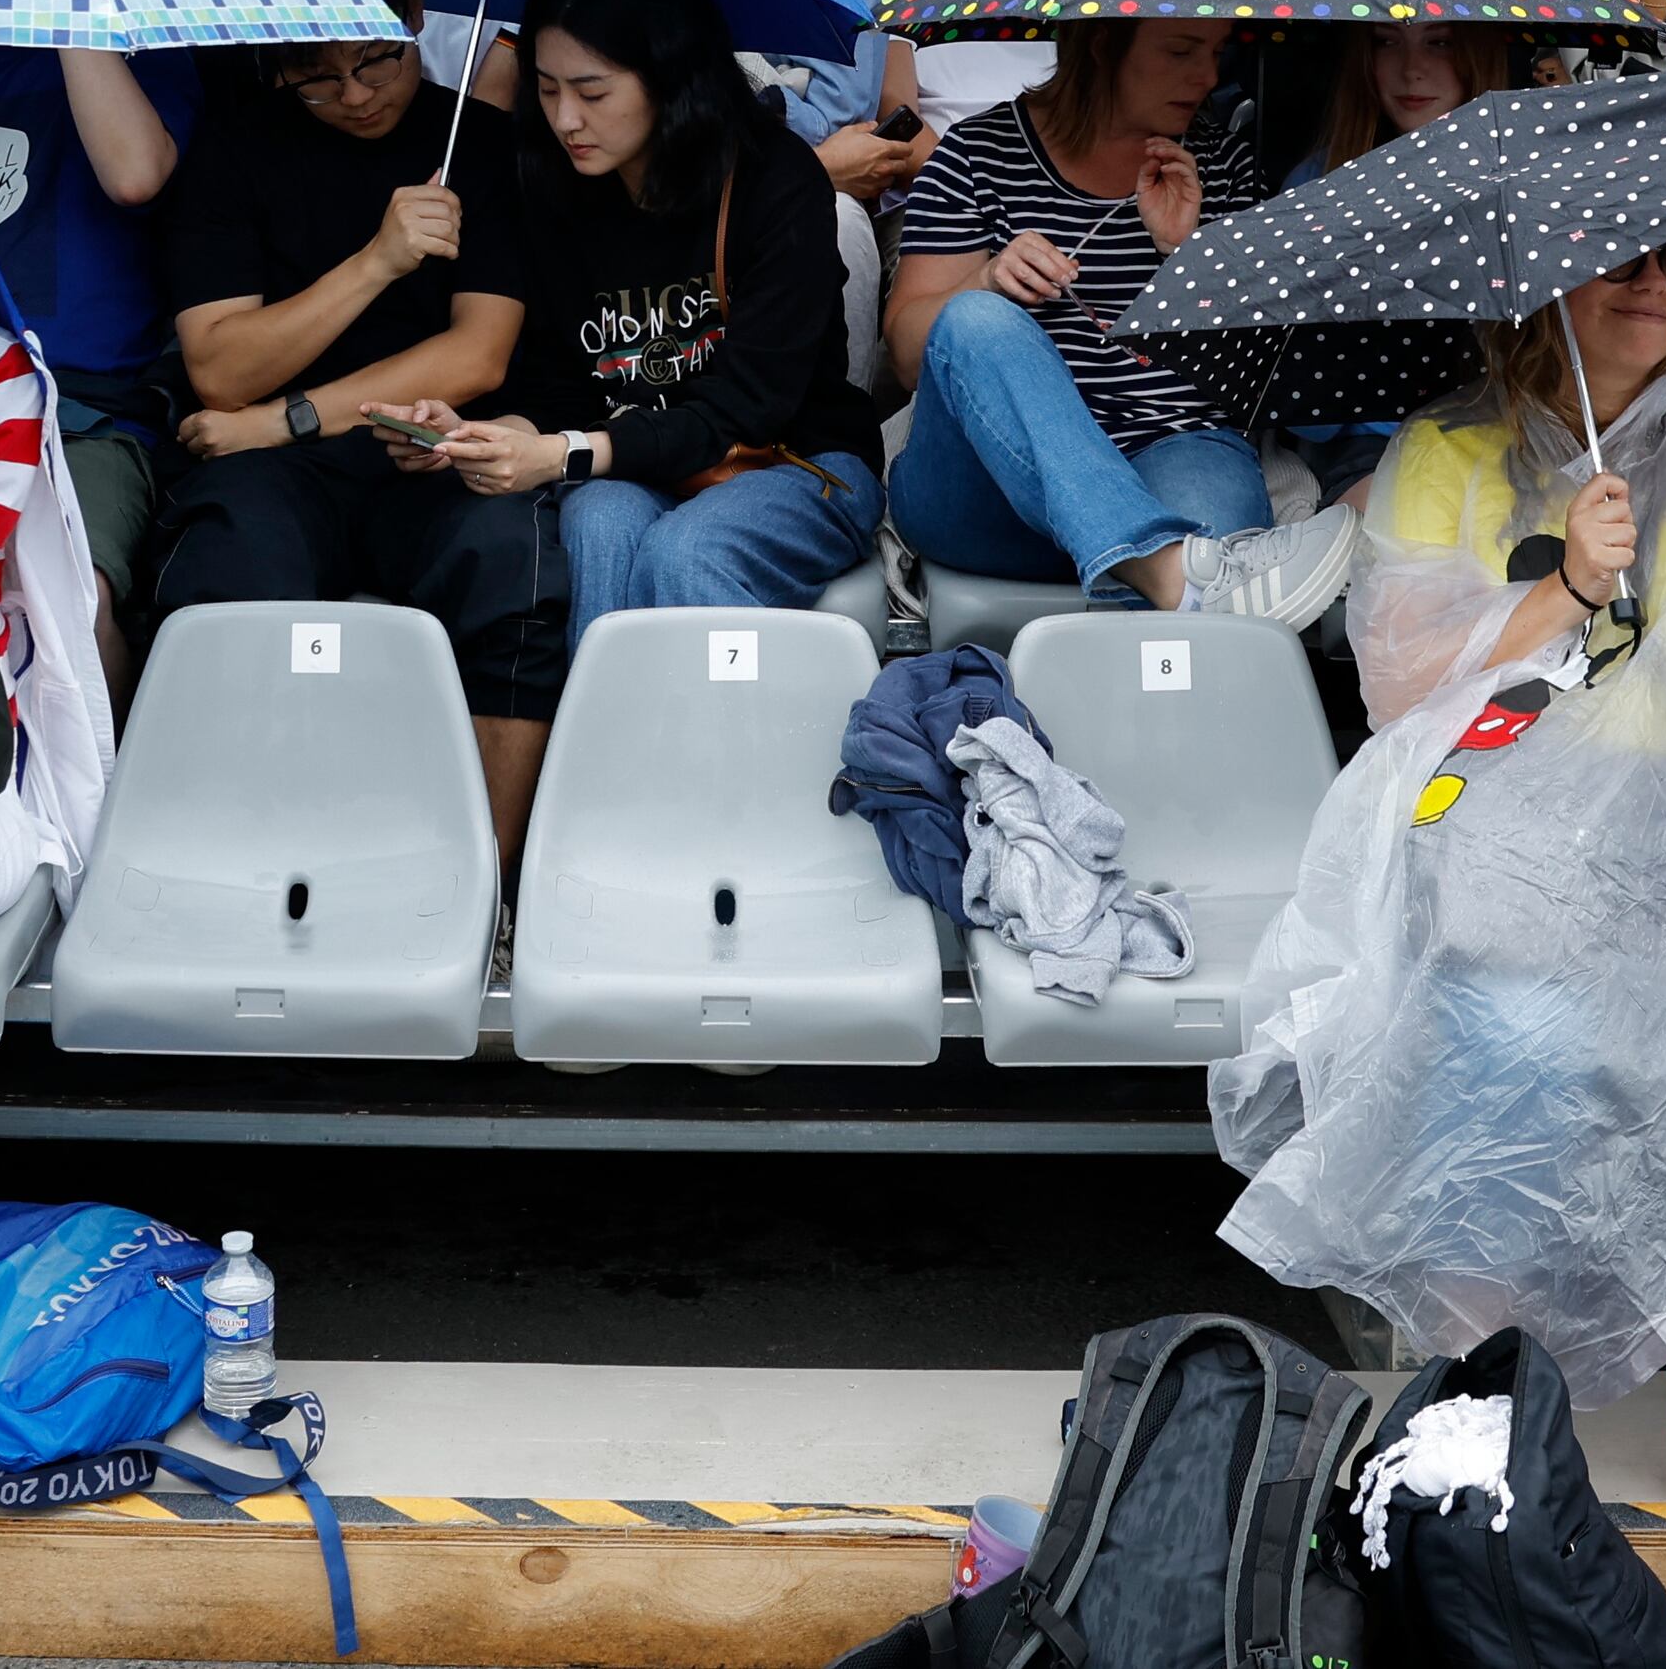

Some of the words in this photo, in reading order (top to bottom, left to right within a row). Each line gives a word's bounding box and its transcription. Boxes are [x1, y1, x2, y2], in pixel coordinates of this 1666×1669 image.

[310, 639, 322, 655] 6
[728, 649, 739, 665] 7
[1160, 659, 1172, 675] 8
[27, 1242, 147, 1330] TOKYO
[290, 1392, 324, 1468] TOK
[47, 1449, 153, 1502] TOKYO
